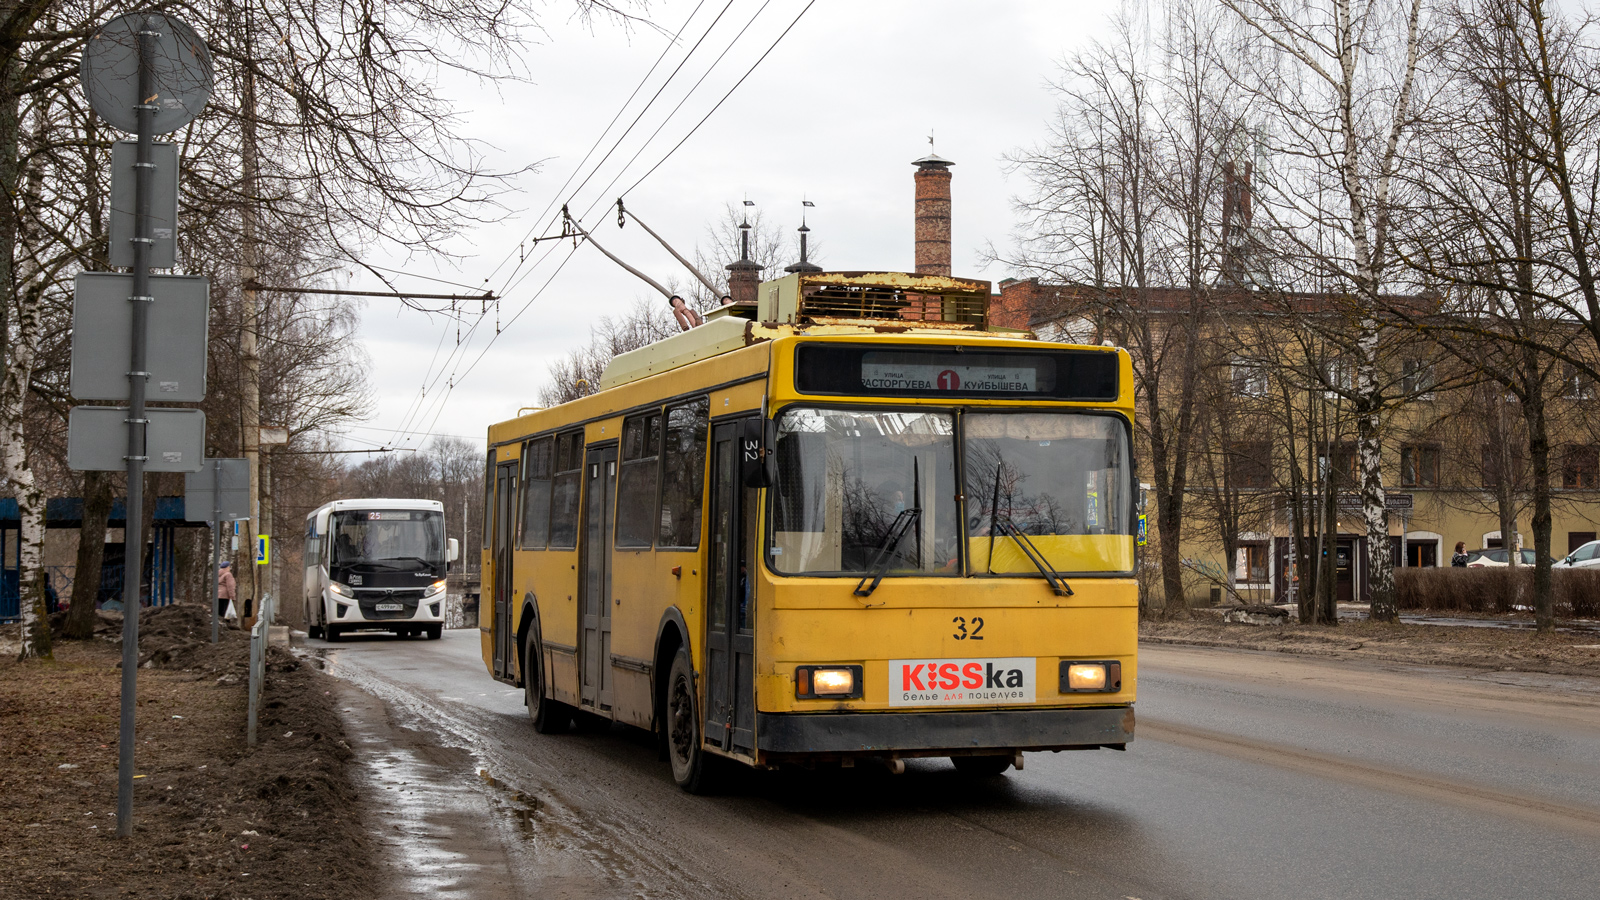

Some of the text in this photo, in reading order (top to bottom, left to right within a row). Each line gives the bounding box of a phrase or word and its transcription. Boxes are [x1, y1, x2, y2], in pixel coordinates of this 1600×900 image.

[942, 372, 952, 390] 1
[964, 380, 1028, 390] КУЙБЫШЕВА
[744, 440, 758, 462] 32
[370, 512, 380, 520] 25
[952, 616, 984, 640] 32
[903, 693, 938, 701] белье
[969, 691, 1024, 700] поцелуев
